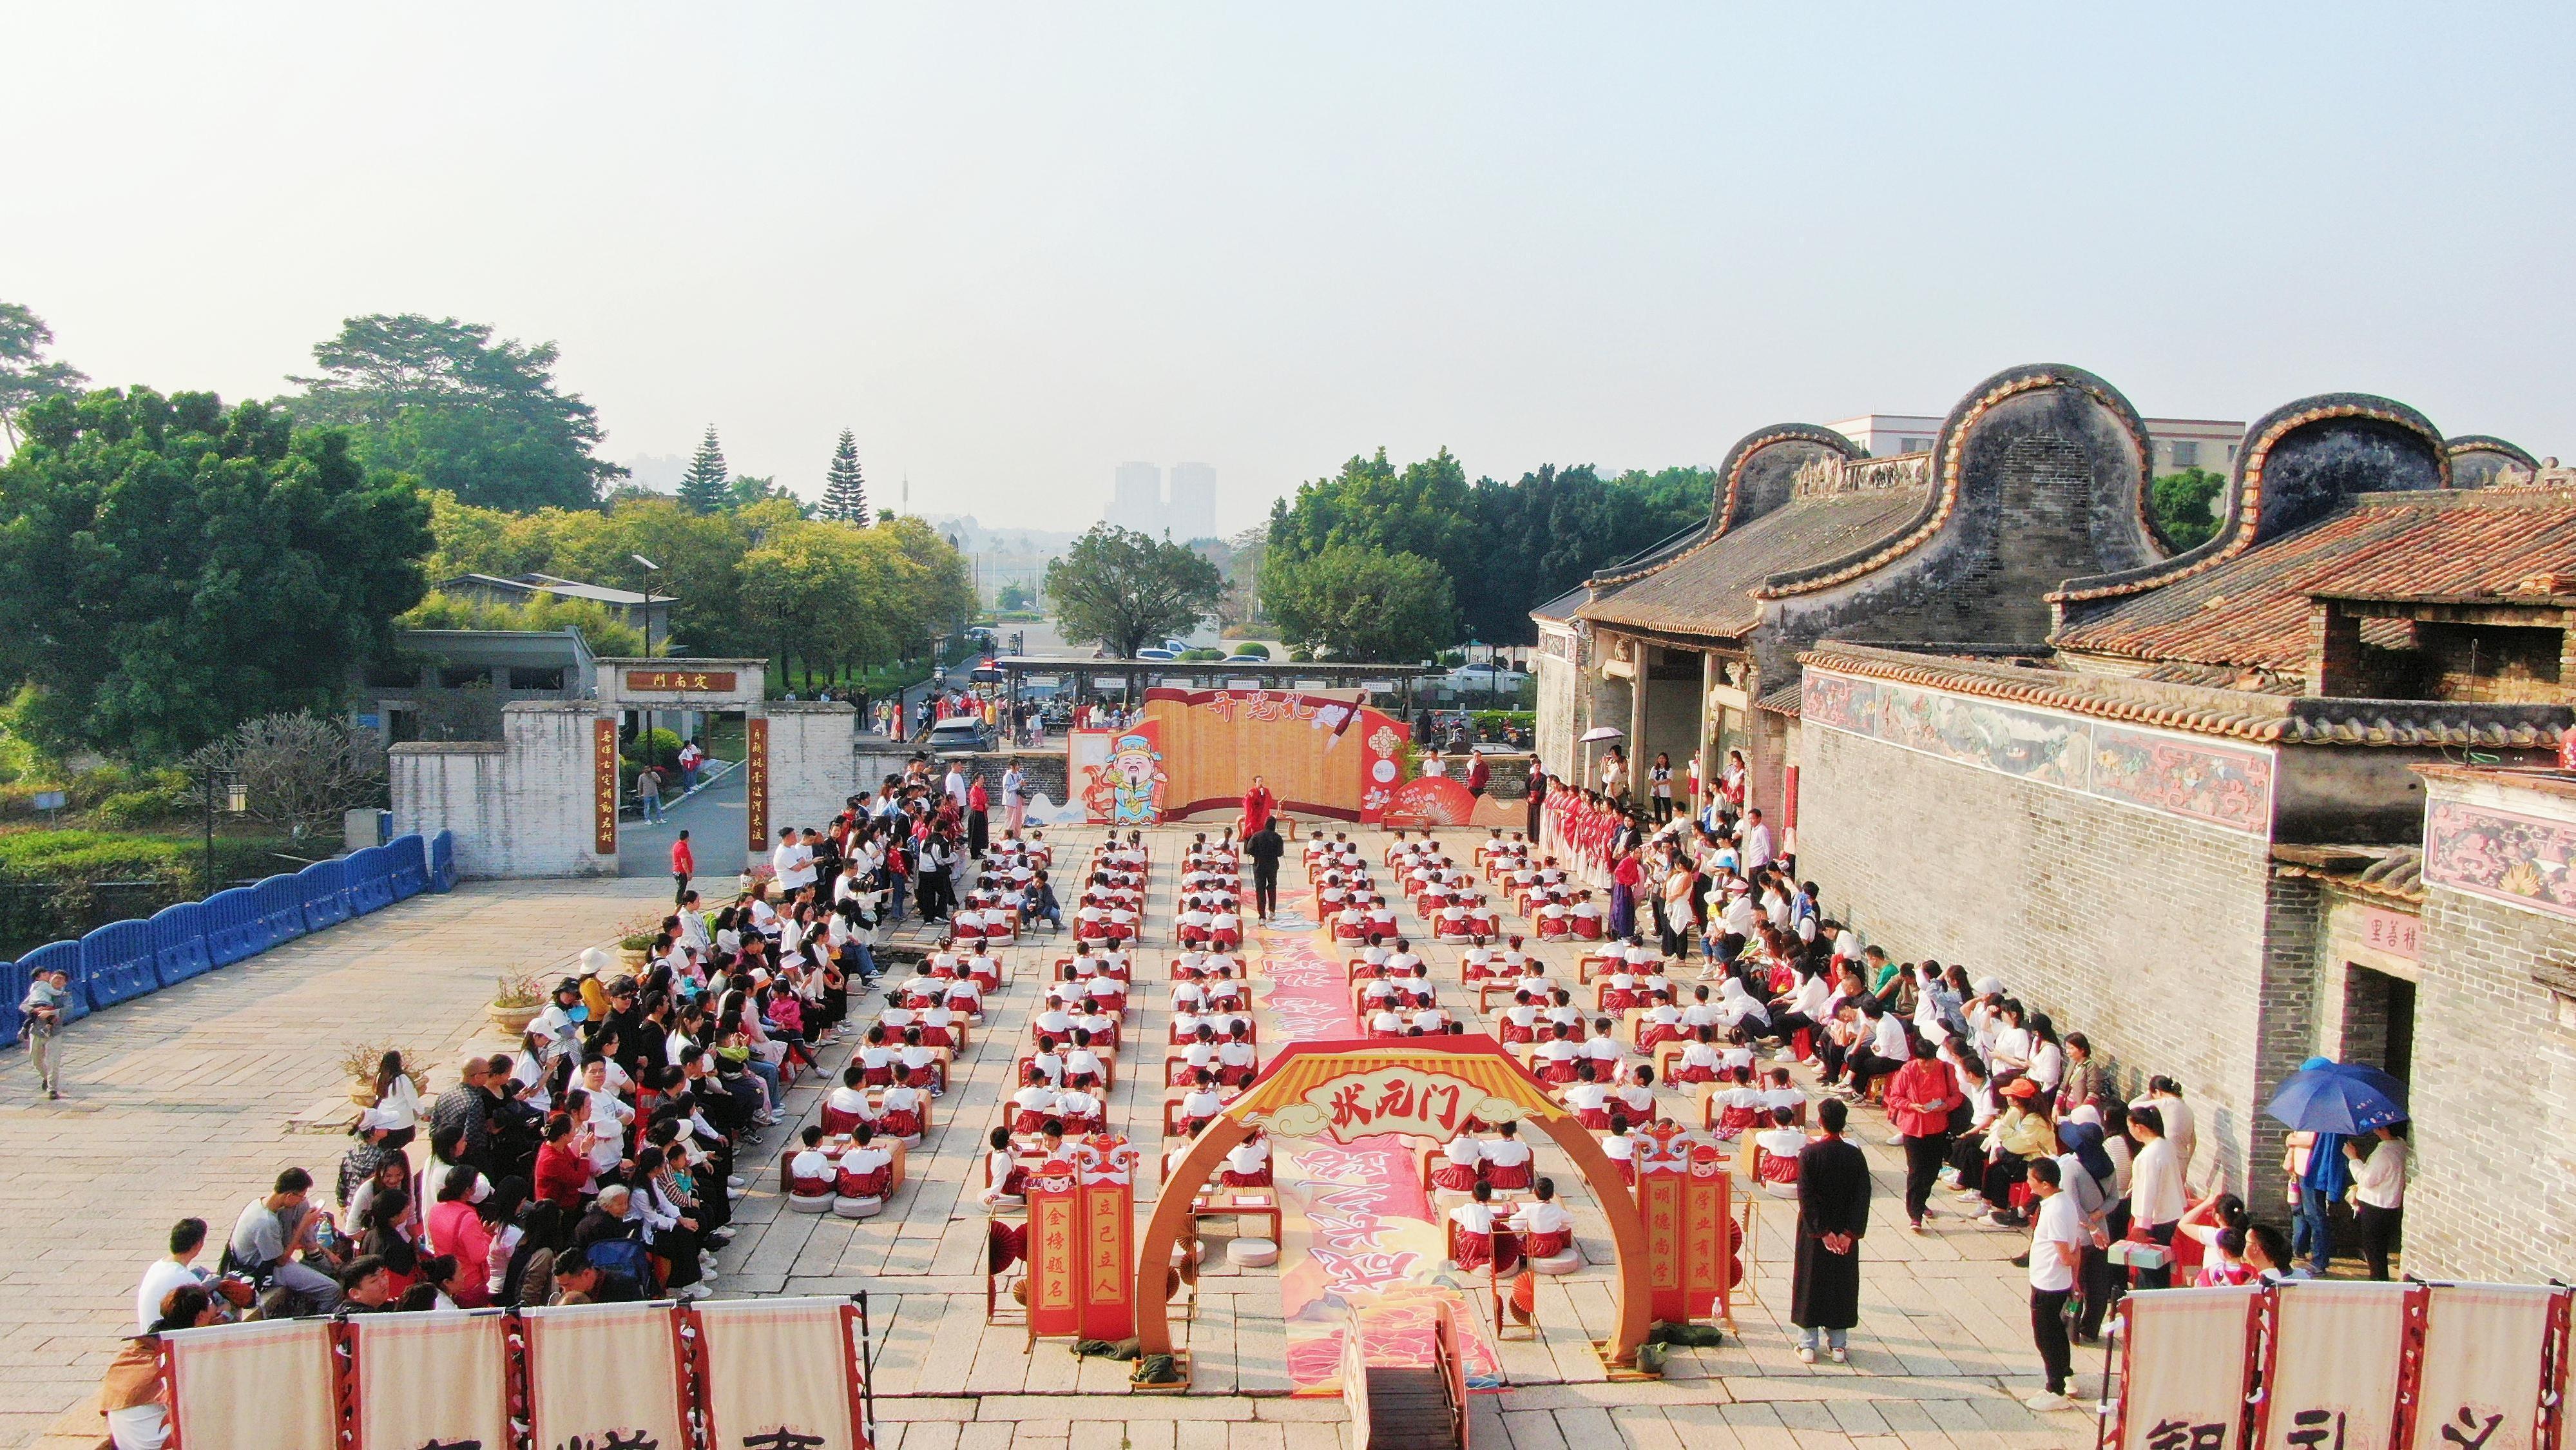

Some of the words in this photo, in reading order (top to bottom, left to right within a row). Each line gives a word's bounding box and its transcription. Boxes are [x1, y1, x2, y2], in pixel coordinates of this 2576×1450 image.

[1207, 691, 1316, 722] 开笔礼
[1331, 1078, 1461, 1130] 状元门
[1046, 1208, 1067, 1297] 金榜题名
[1097, 1199, 1117, 1292] 立己立人
[1654, 1188, 1670, 1281] 明德尚学
[1695, 1191, 1712, 1281] 学业有成
